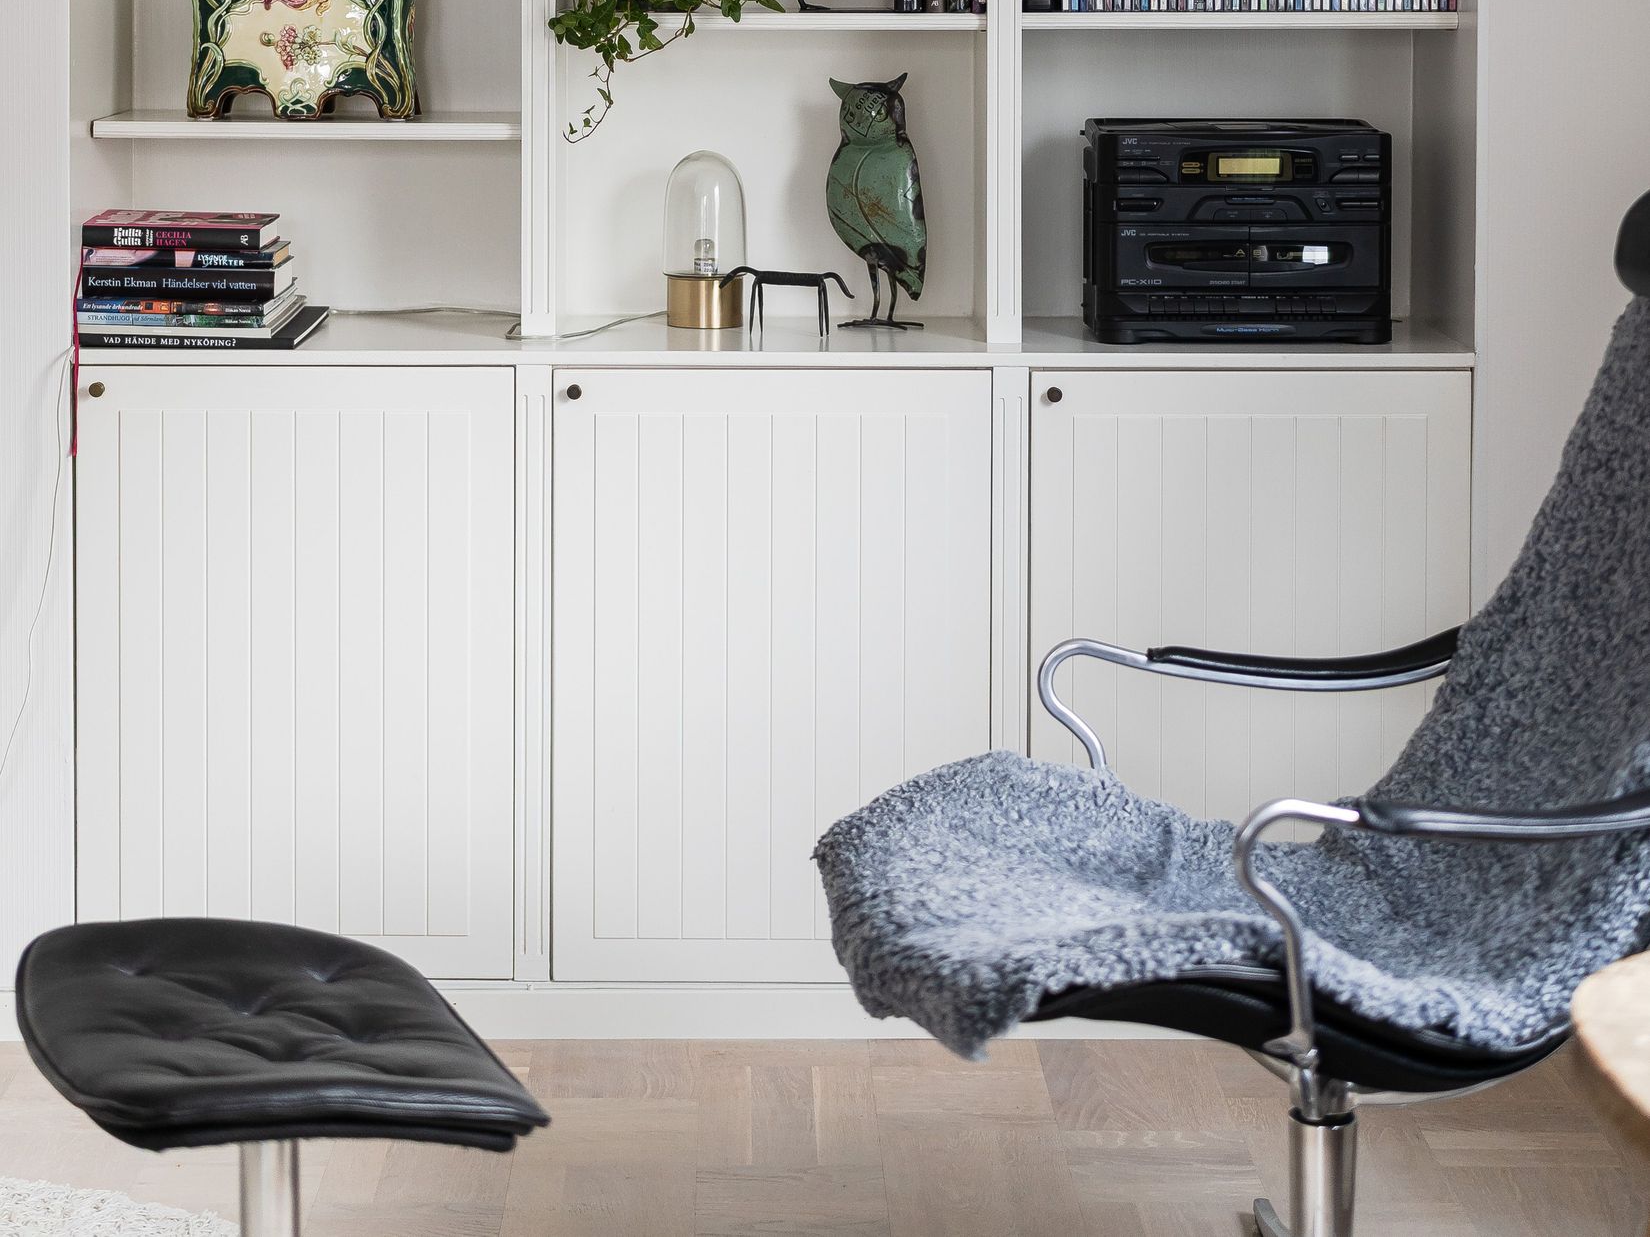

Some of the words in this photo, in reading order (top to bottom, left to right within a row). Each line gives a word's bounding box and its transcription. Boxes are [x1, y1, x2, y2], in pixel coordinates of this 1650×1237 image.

[1122, 137, 1138, 145] JVC
[155, 231, 192, 239] CECILIA
[156, 238, 188, 247] HAGEN
[197, 254, 228, 262] LYSANDE
[88, 276, 121, 287] Kerstin
[124, 277, 157, 288] Ekman
[162, 278, 210, 289] Händelser
[212, 279, 227, 289] vid
[229, 281, 257, 290] vatten
[103, 336, 121, 344] VAD
[125, 336, 157, 345] HÄNDE
[160, 337, 180, 345] MED
[183, 338, 237, 347] NYKÖPING?
